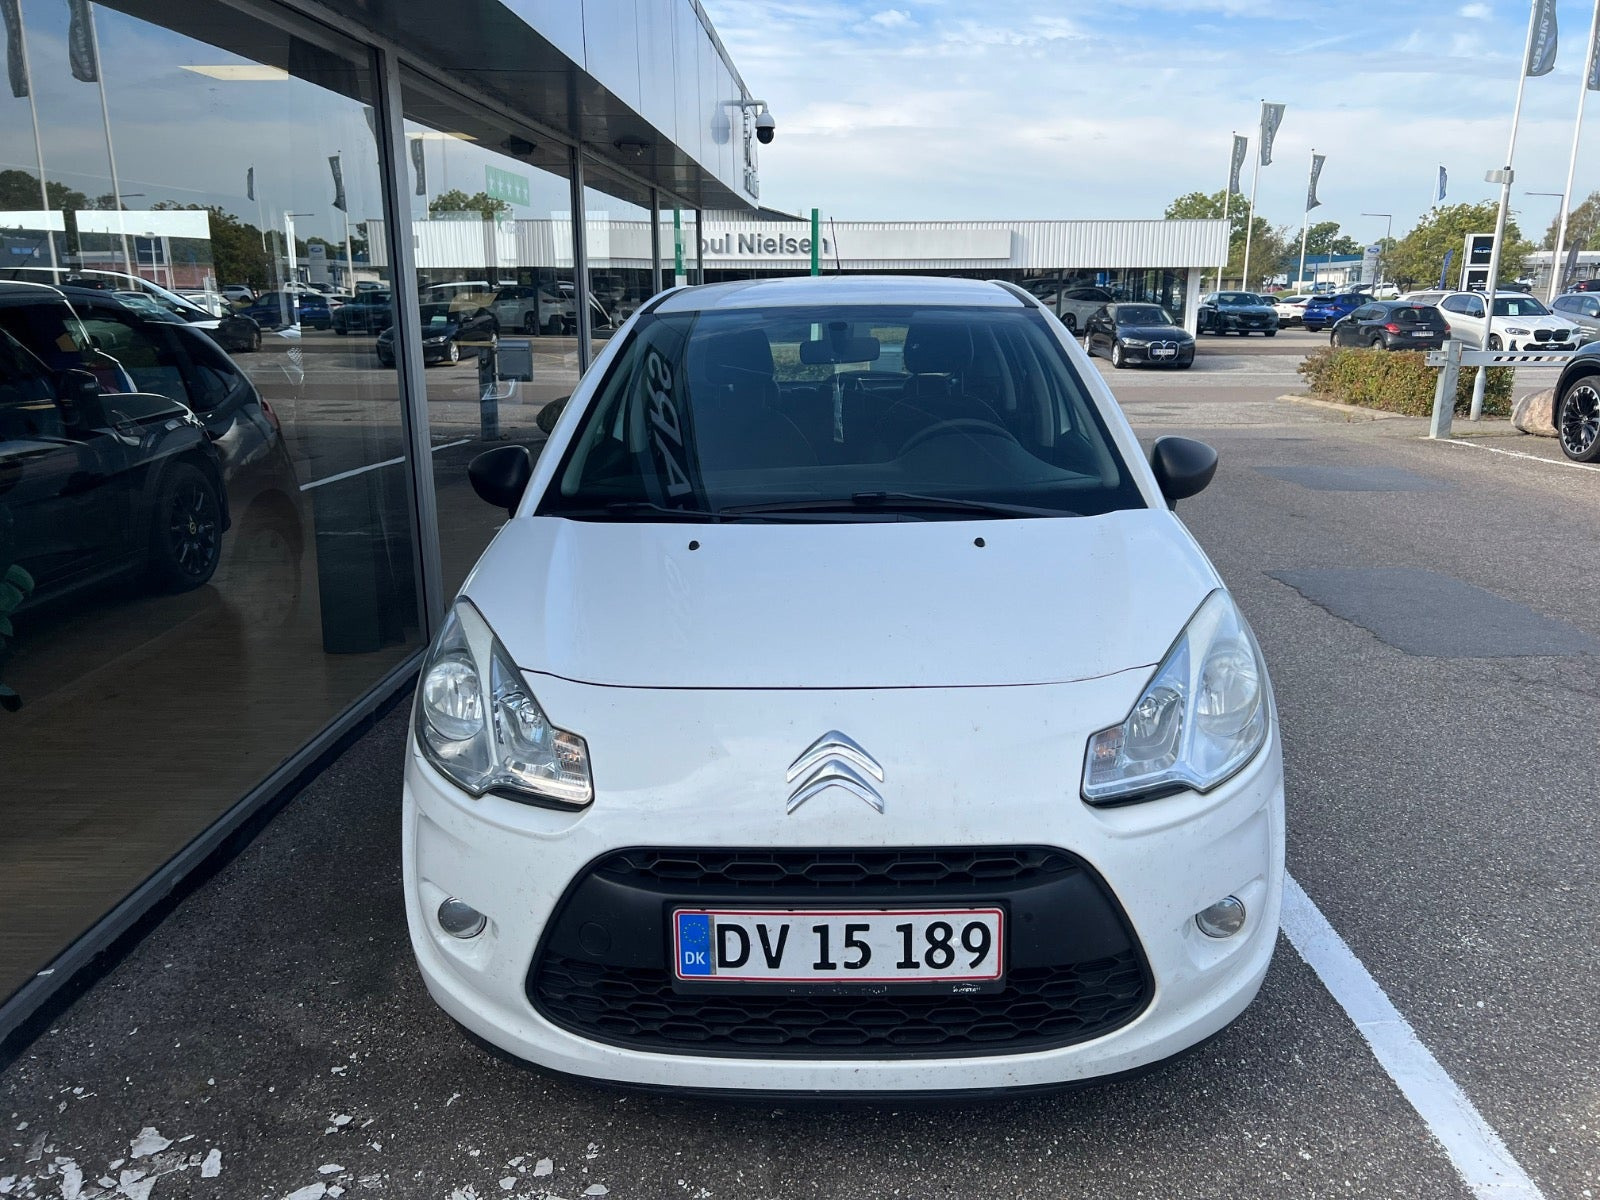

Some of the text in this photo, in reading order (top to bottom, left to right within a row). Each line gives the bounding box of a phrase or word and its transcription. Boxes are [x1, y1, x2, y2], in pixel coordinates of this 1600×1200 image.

[702, 233, 730, 254] oul
[716, 921, 991, 970] DV 15 189
[685, 951, 706, 965] DK
